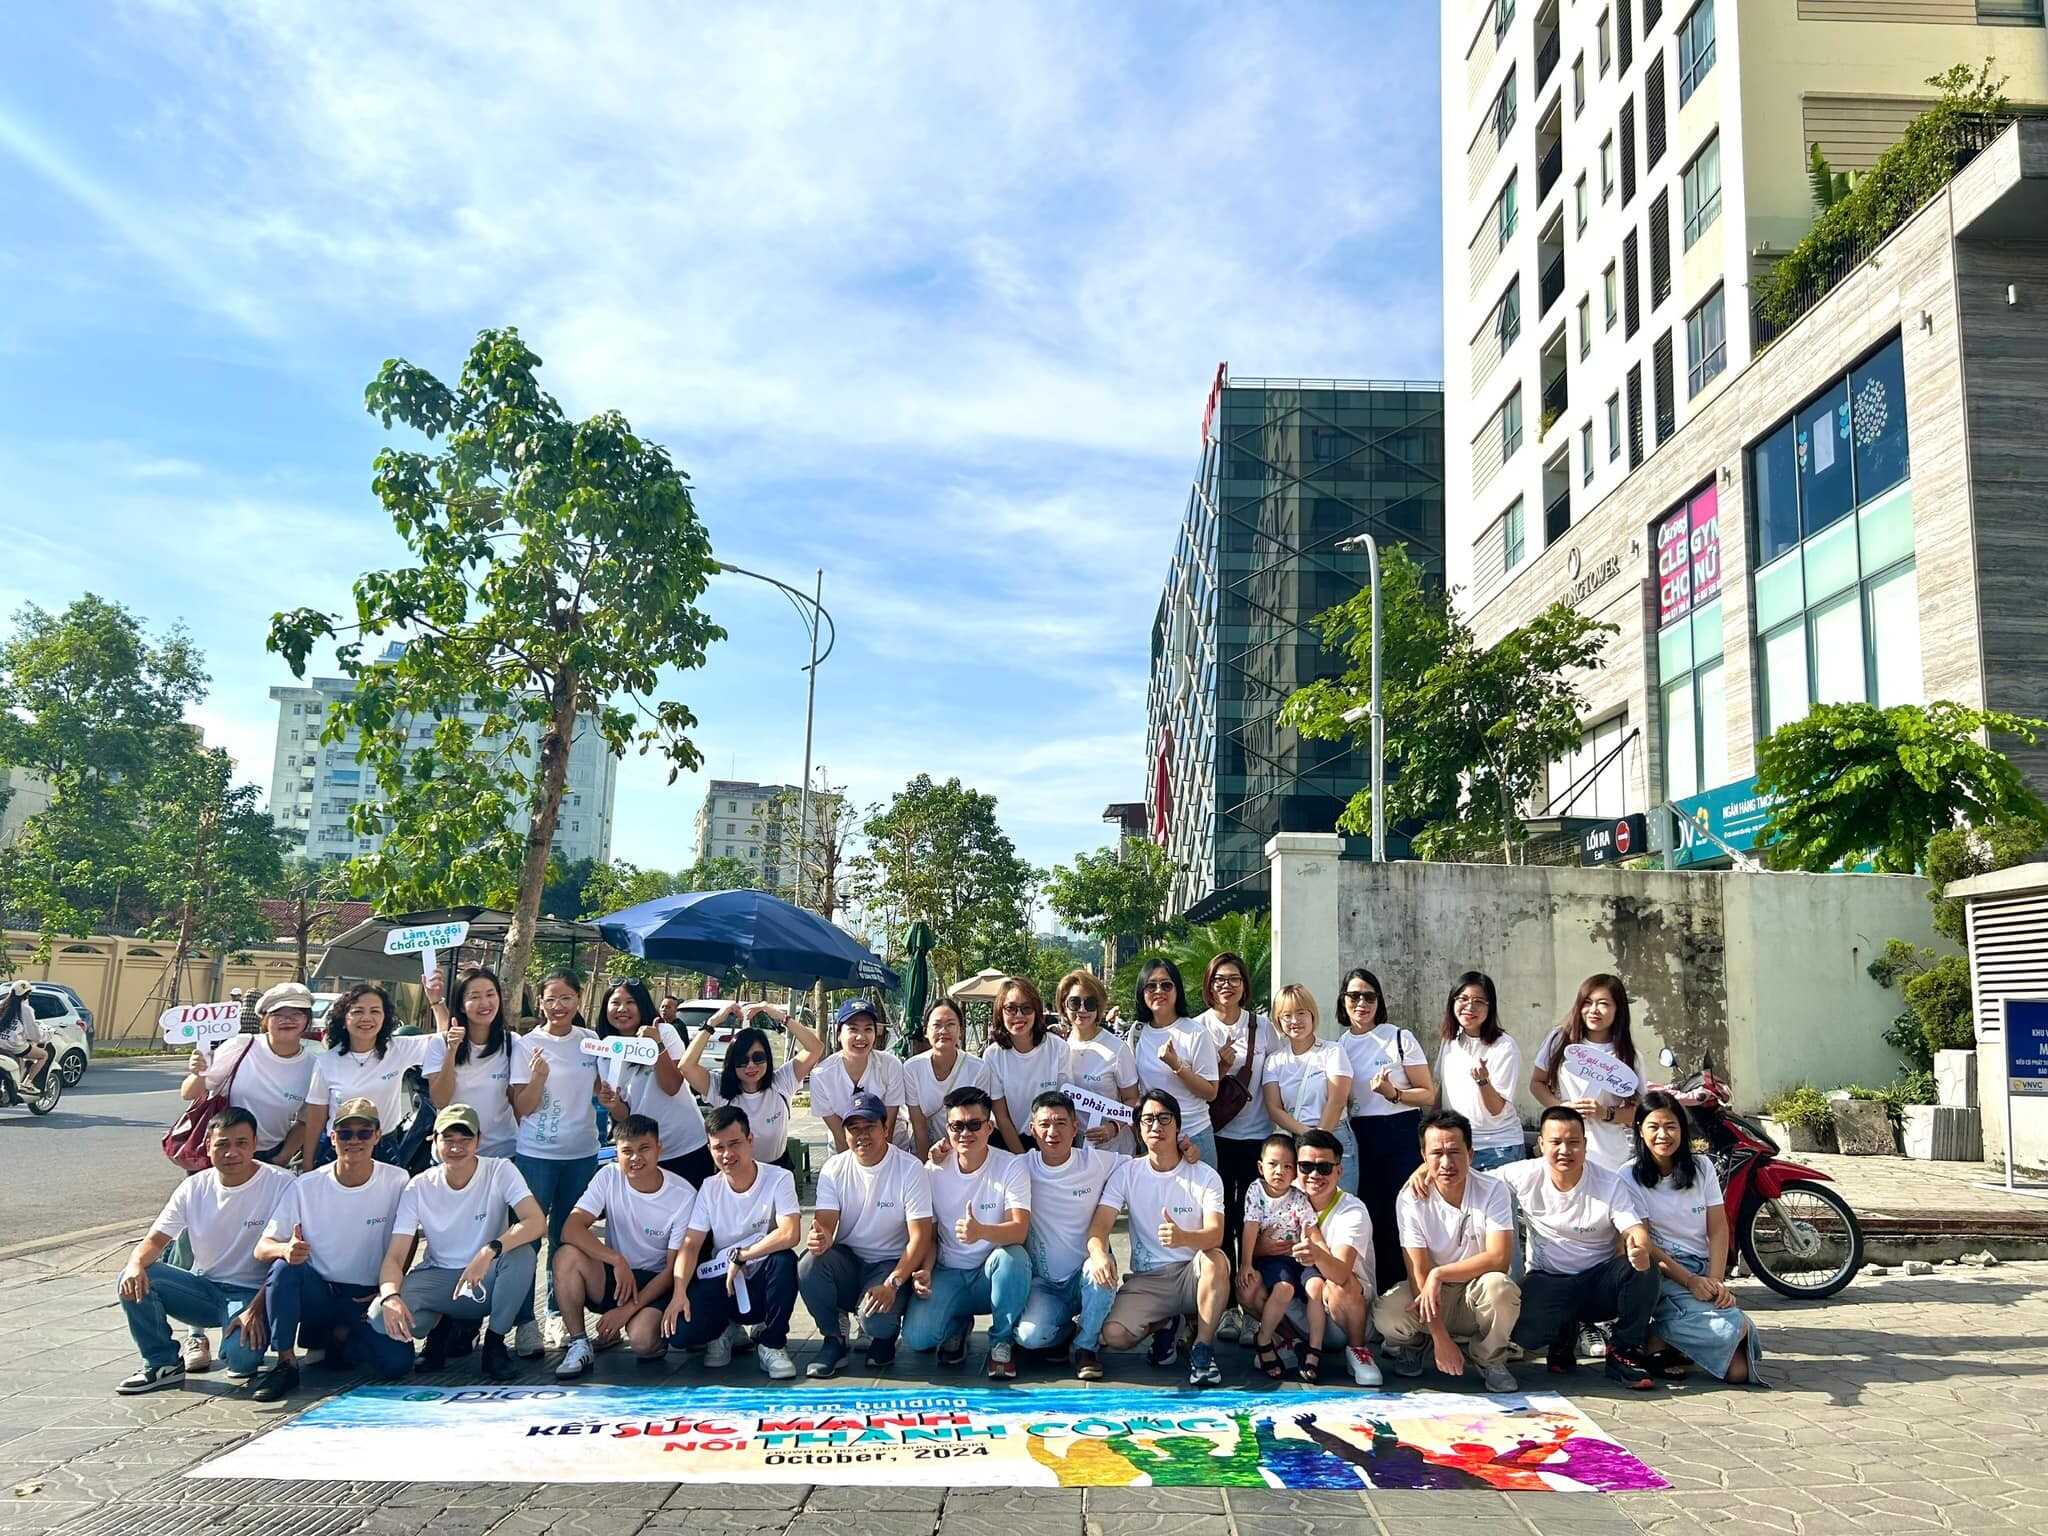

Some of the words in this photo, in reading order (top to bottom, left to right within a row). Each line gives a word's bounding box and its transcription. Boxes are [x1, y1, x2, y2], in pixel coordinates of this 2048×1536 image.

[1659, 541, 1687, 577] CLB
[1661, 569, 1689, 608] CHO
[1586, 829, 1598, 851] LỐI
[1599, 830, 1611, 848] RA
[402, 929, 427, 940] Làm
[444, 924, 462, 937] đội
[390, 939, 416, 951] Chơi
[432, 935, 451, 947] hội
[180, 1005, 238, 1024] LOVE
[197, 1020, 232, 1040] pico
[584, 1041, 596, 1051] We
[596, 1043, 610, 1053] are
[623, 1041, 656, 1059] pico
[1579, 1066, 1604, 1082] pico
[2022, 1081, 2043, 1089] VNVC
[1082, 1096, 1106, 1113] phải
[880, 1200, 895, 1210] pico
[1178, 1206, 1193, 1215] pico
[247, 1219, 265, 1229] pico
[371, 1216, 388, 1226] pico
[700, 1266, 713, 1275] We
[713, 1262, 726, 1271] are
[440, 1387, 568, 1405] pico
[766, 1403, 841, 1413] Team
[855, 1398, 968, 1411] building
[526, 1420, 610, 1437] KẾT
[610, 1416, 738, 1438] SỨC
[663, 1437, 748, 1452] NỐI
[753, 1425, 1008, 1449] THÀNH
[1026, 1416, 1231, 1438] CÔNG
[764, 1452, 898, 1466] October,
[914, 1446, 990, 1459] 2024
